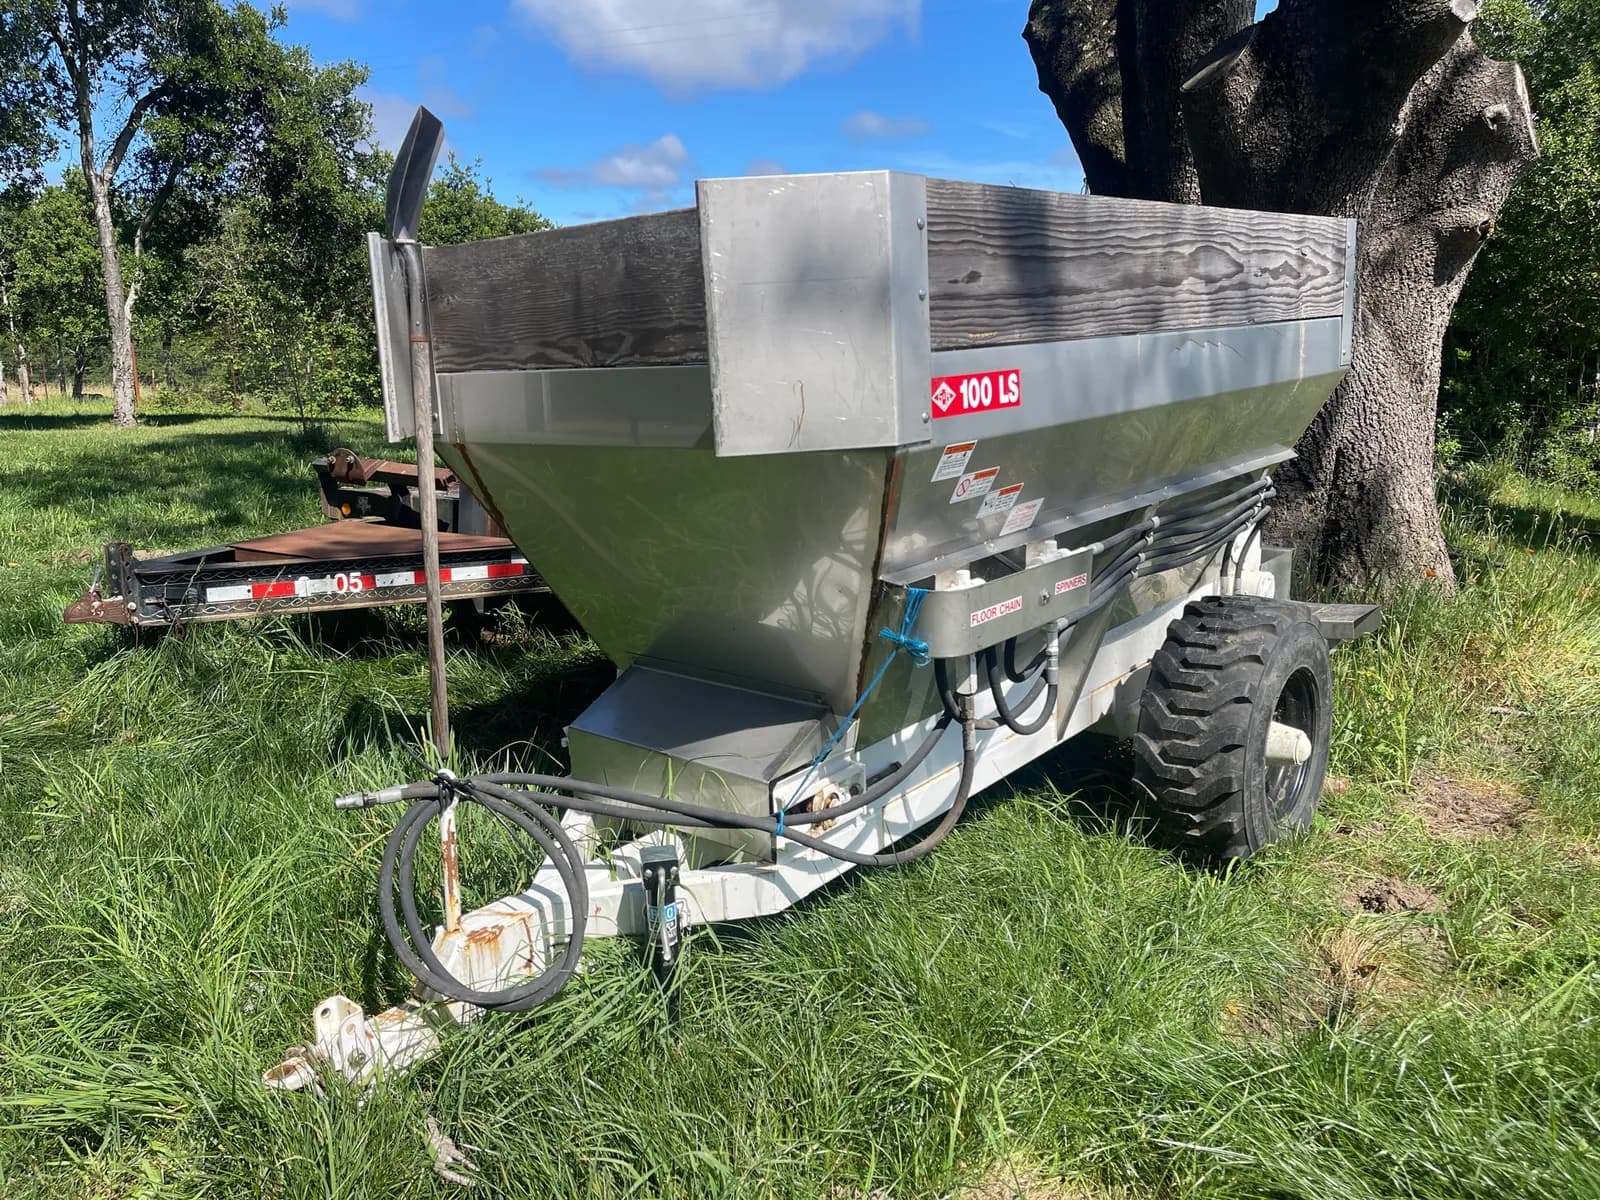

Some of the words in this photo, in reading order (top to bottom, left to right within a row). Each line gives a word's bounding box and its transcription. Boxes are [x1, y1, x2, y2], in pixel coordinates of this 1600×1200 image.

[959, 375, 993, 410] 100
[998, 373, 1019, 404] LS
[1055, 575, 1087, 593] SPINNERS
[971, 607, 997, 625] FLOOR
[999, 598, 1021, 615] CHAIN
